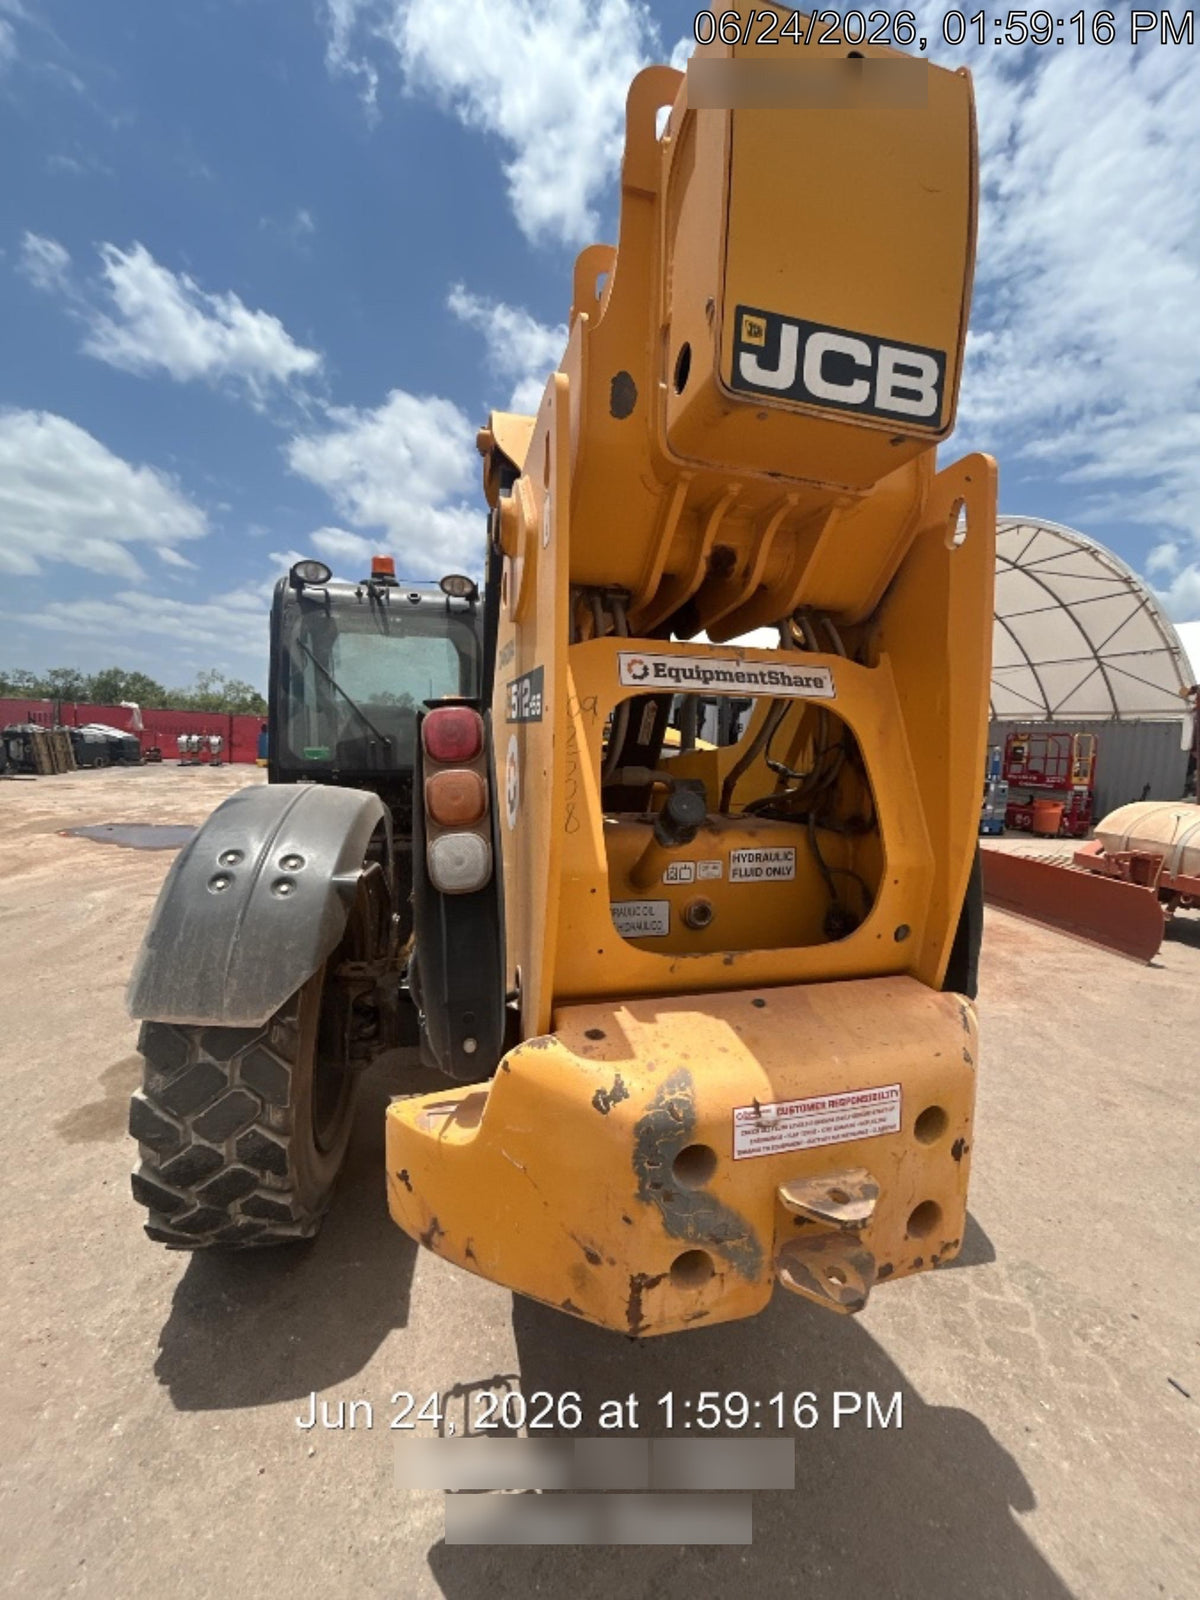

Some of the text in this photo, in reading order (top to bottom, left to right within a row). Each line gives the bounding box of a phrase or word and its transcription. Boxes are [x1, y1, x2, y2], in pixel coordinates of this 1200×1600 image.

[739, 323, 939, 417] JCB
[652, 662, 825, 688] EquipmentShare
[732, 851, 793, 863] HYDRAULIC
[732, 867, 763, 878] FLUID
[765, 866, 793, 877] ONLY
[776, 1101, 826, 1116] CUSTOMER
